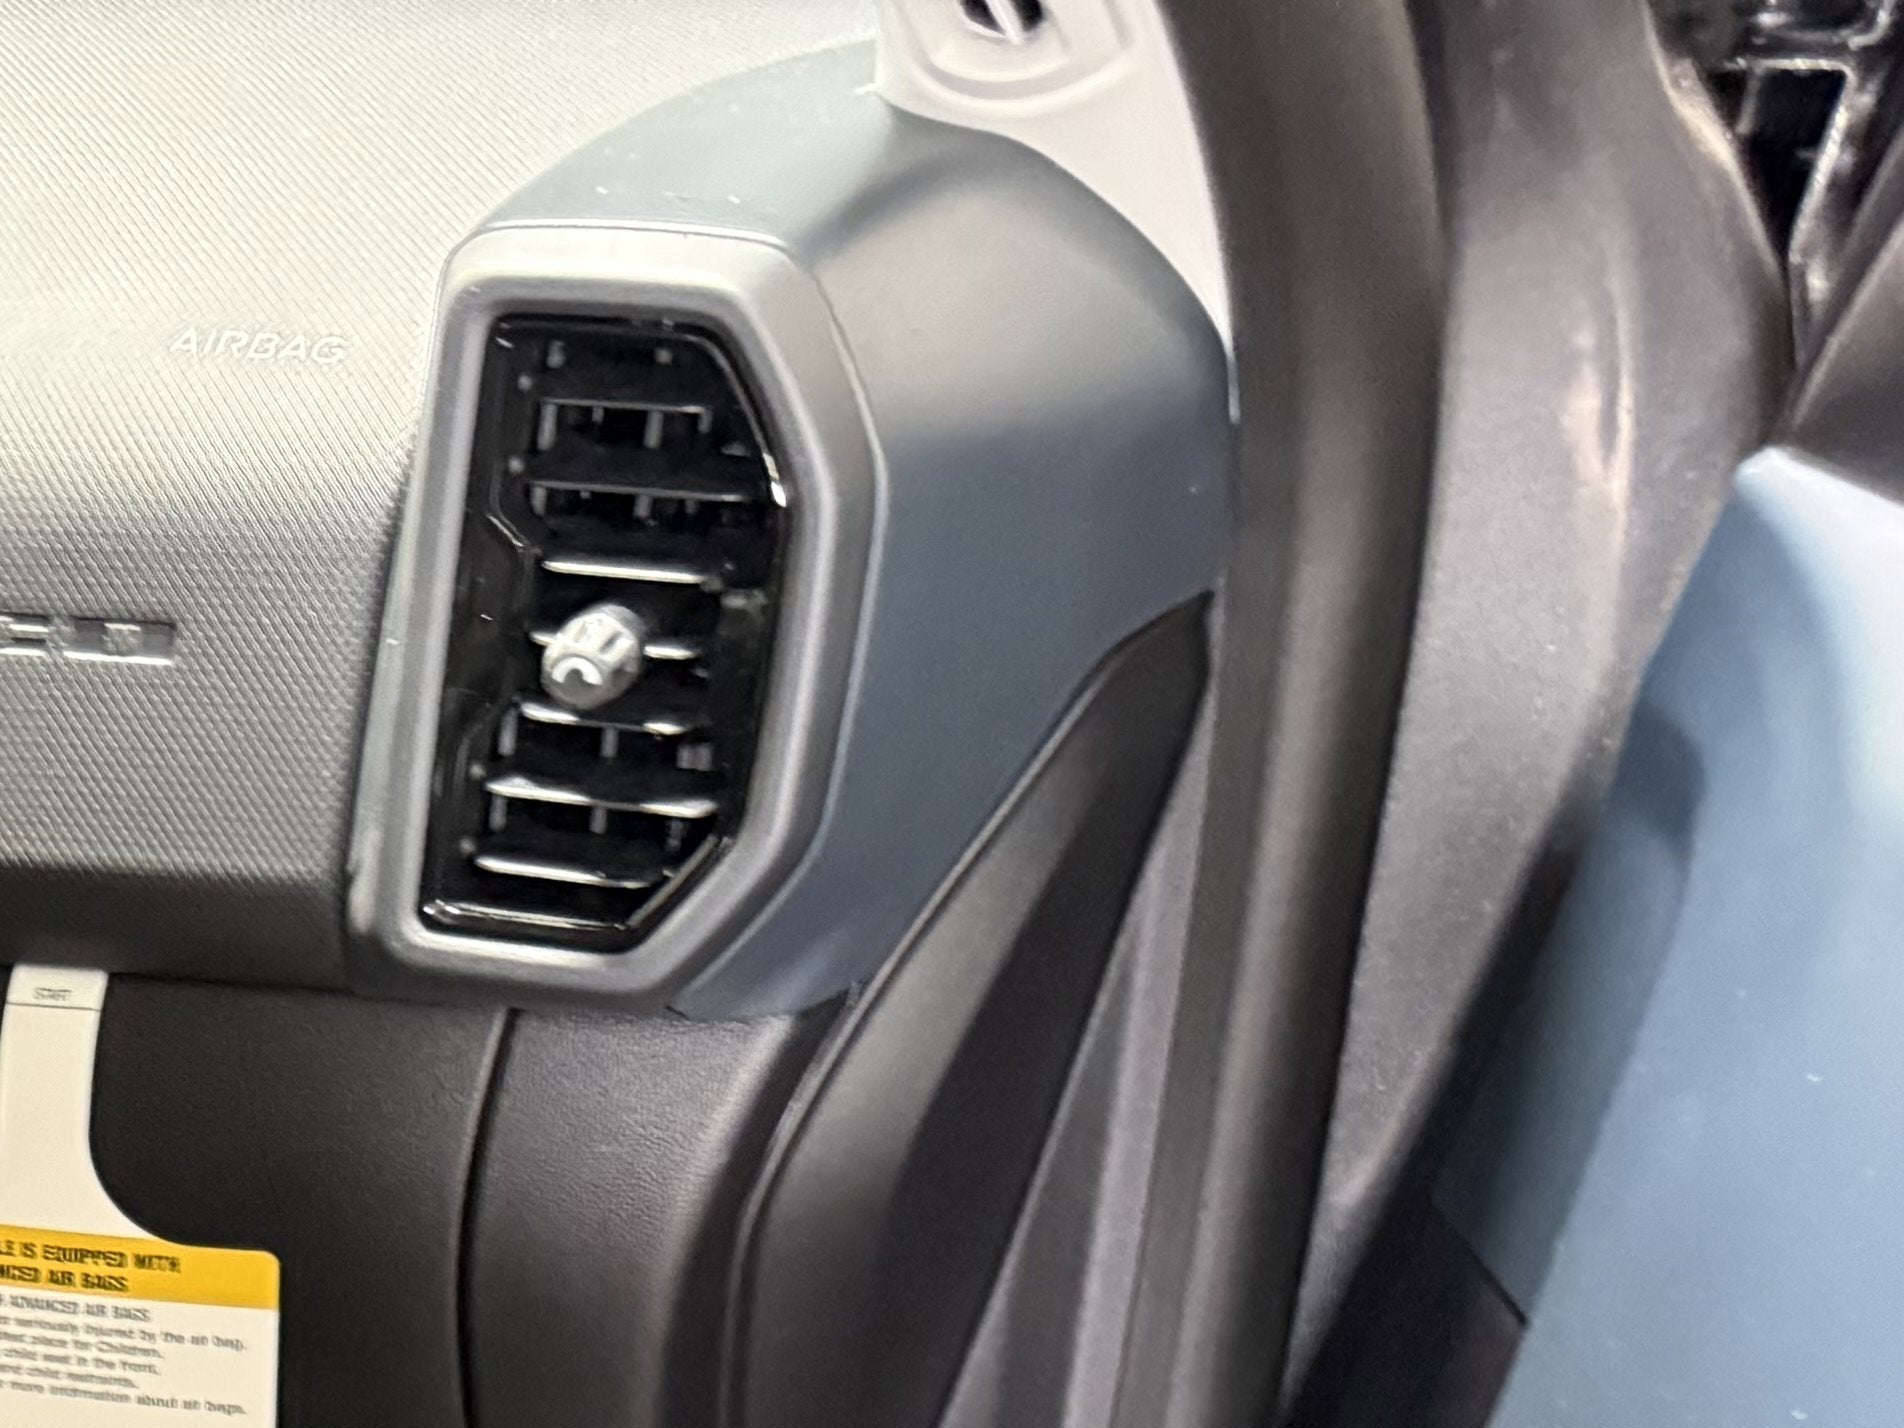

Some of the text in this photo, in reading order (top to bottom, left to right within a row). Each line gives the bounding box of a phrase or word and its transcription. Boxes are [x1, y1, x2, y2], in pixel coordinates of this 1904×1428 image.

[169, 327, 349, 365] AIRBAG
[20, 1241, 37, 1258] IS
[42, 1244, 128, 1268] EQUIPPED
[133, 1252, 181, 1273] WITH
[48, 1268, 76, 1287] AIR
[81, 1271, 129, 1292] BAGS
